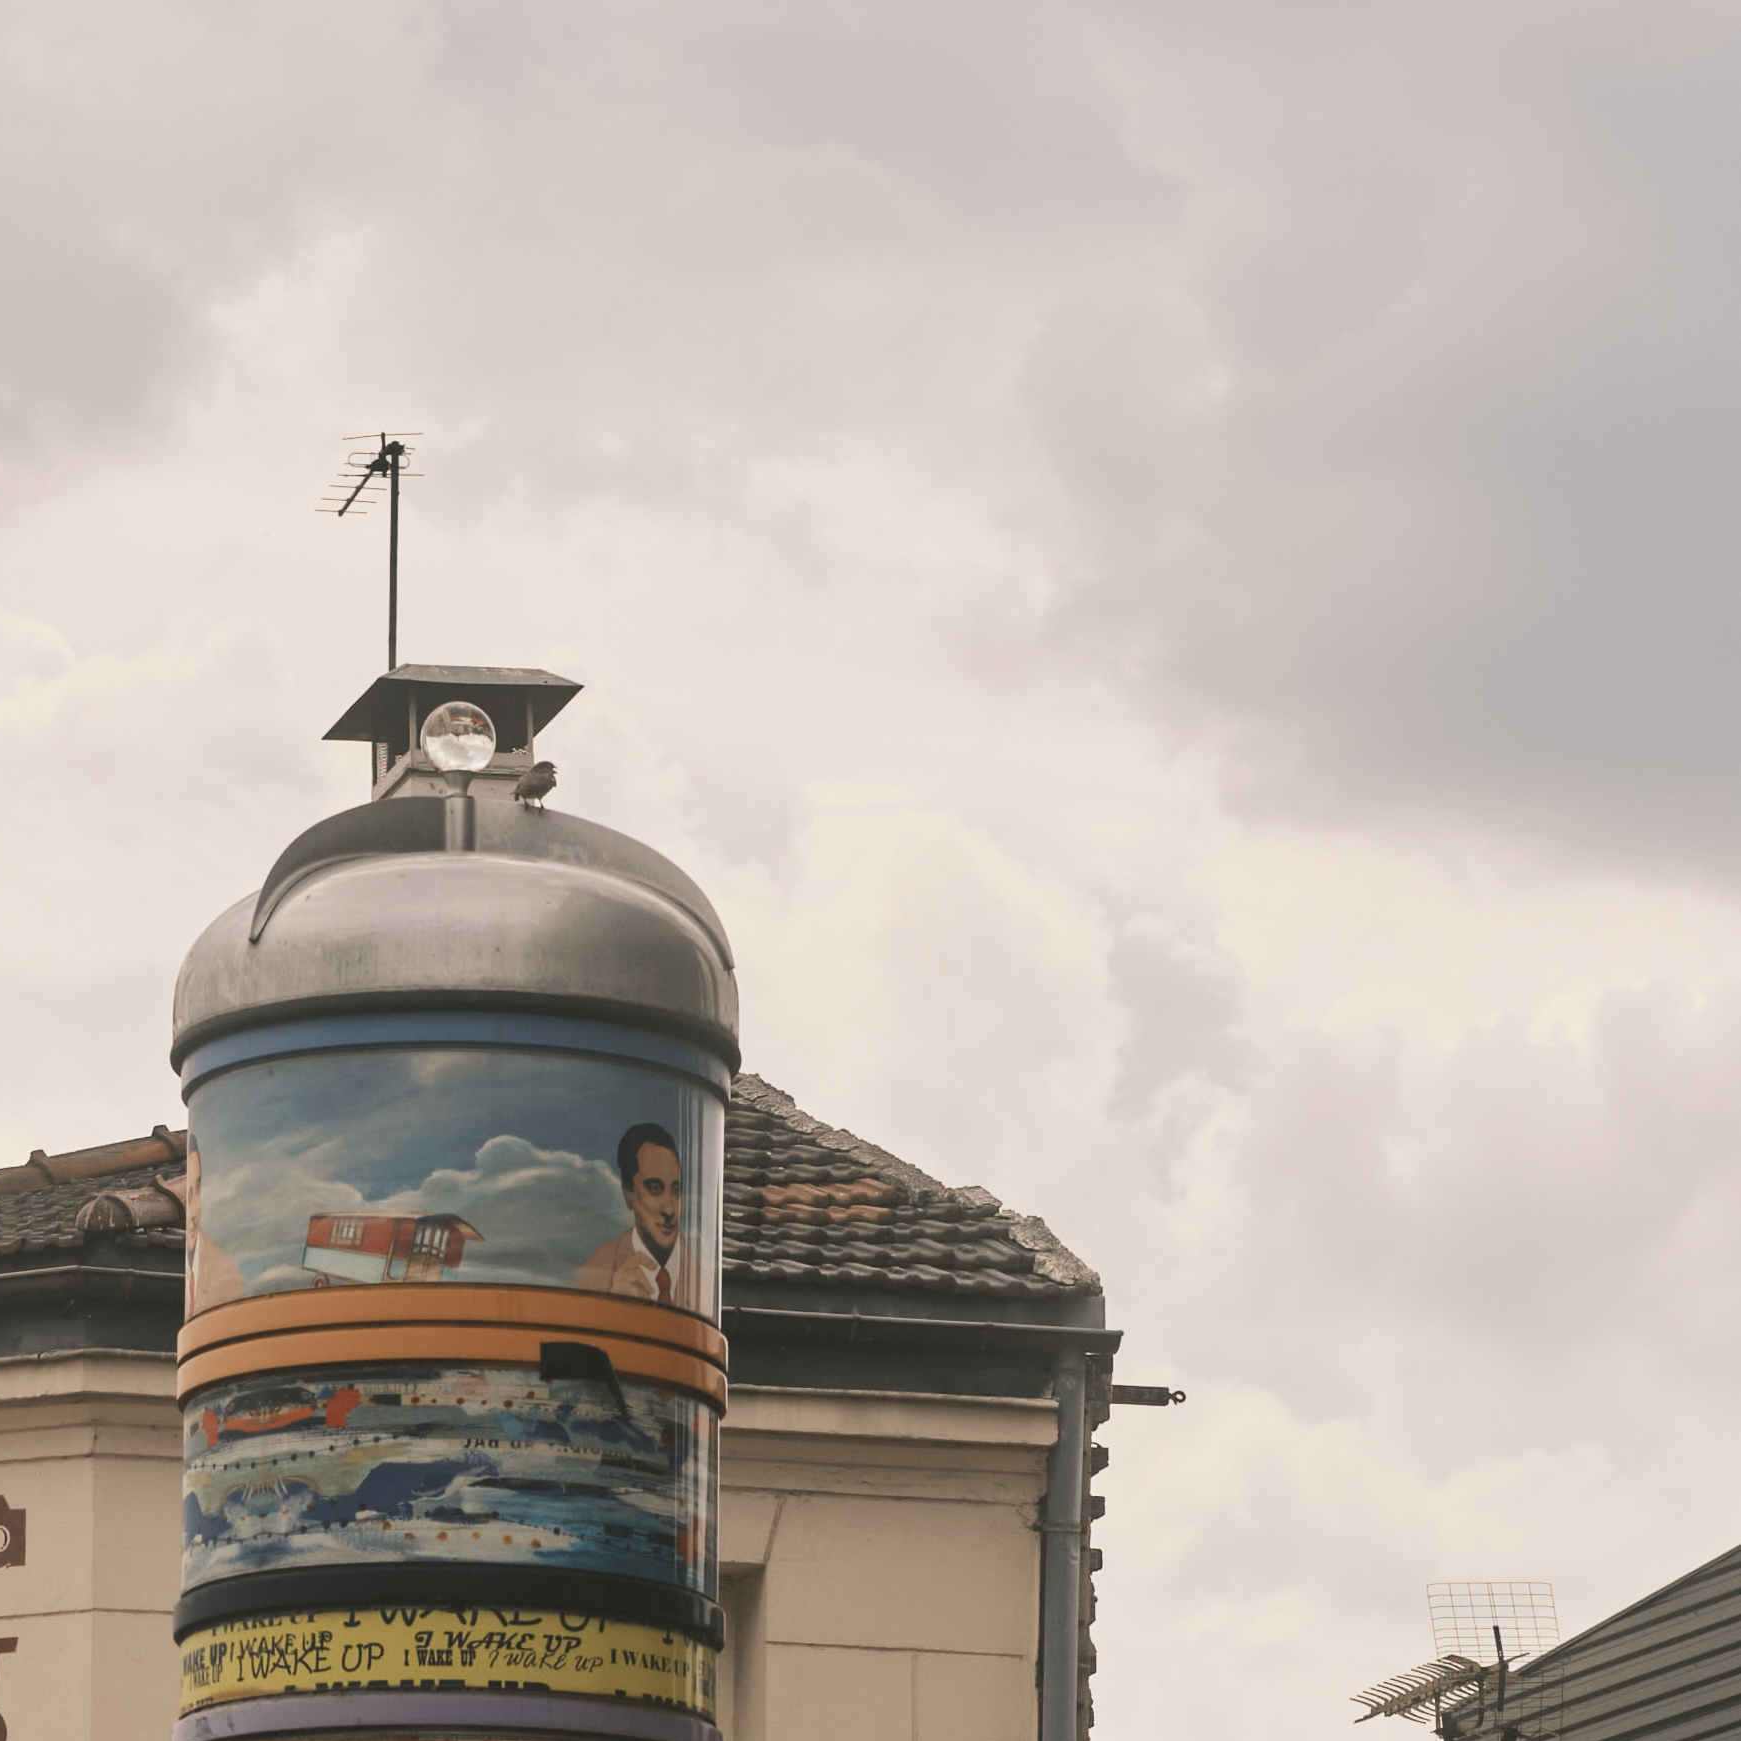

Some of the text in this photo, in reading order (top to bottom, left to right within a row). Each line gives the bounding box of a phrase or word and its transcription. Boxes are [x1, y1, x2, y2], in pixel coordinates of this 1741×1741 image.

[443, 1631, 536, 1651] WAKE
[542, 1633, 583, 1654] UP
[250, 1648, 332, 1679] WAKE
[341, 1642, 385, 1672] UP
[416, 1649, 453, 1667] WAKE
[461, 1649, 476, 1667] UP
[621, 1650, 672, 1674] WAKE
